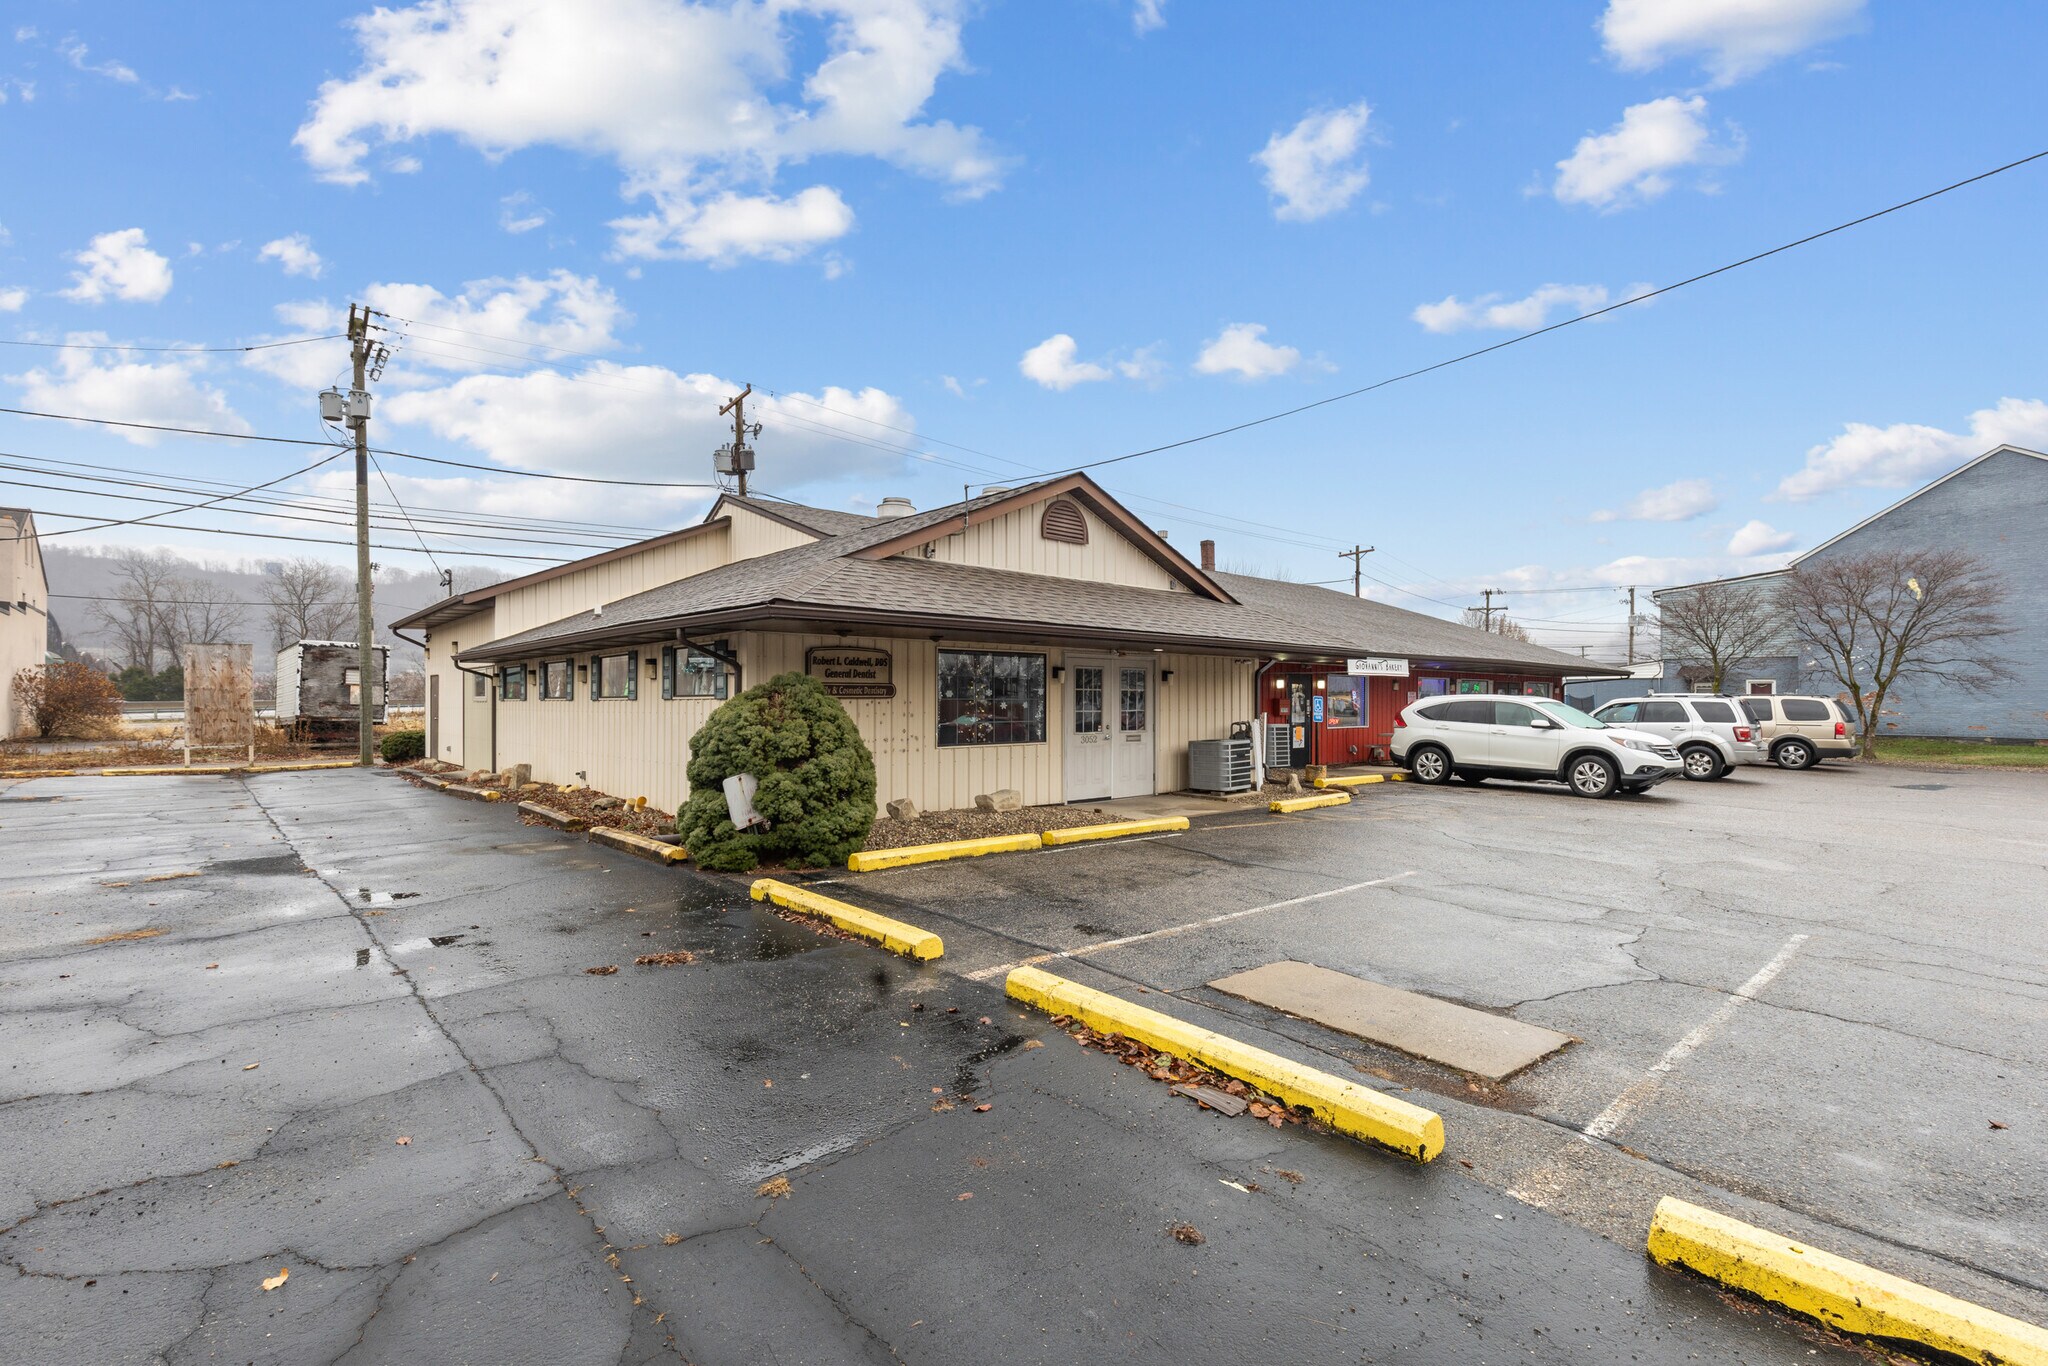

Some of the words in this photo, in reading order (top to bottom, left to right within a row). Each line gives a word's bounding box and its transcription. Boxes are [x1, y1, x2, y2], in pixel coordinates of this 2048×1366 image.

[813, 656, 835, 666] Robert
[875, 658, 888, 667] DDS
[825, 668, 851, 678] General
[853, 669, 876, 679] Dentist
[839, 686, 863, 695] Cosmetic
[1080, 735, 1097, 744] 3052
